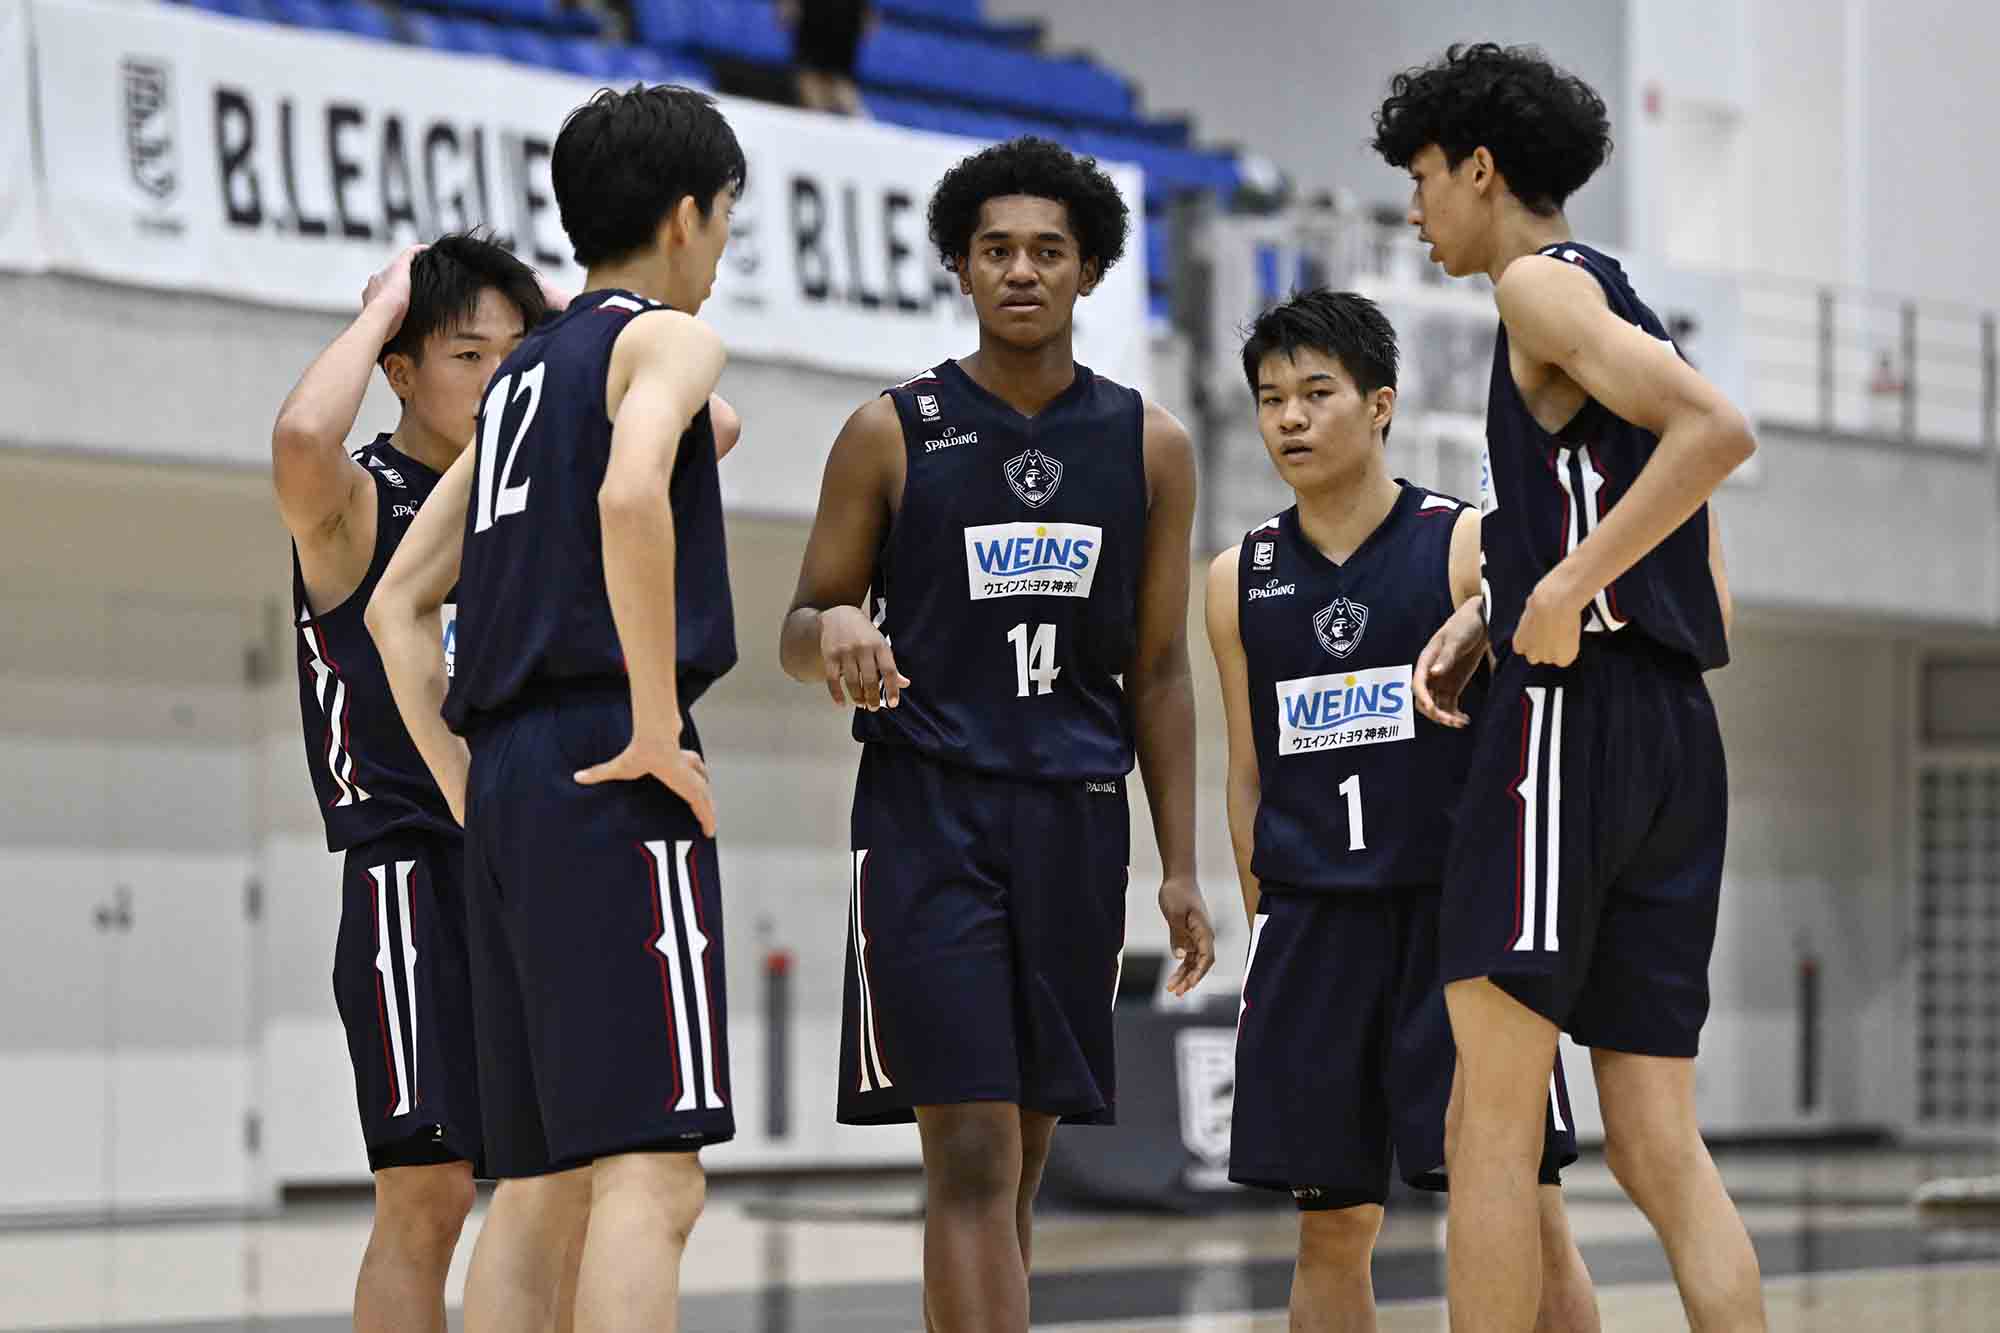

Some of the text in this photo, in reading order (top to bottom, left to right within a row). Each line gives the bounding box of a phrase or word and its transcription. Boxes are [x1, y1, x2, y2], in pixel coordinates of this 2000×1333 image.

[213, 86, 564, 268] B.LEAGUE
[474, 361, 546, 534] 12
[925, 432, 978, 453] SPALDING
[1248, 584, 1296, 601] SPALDING
[1007, 623, 1062, 697] 14
[1338, 774, 1366, 851] 1
